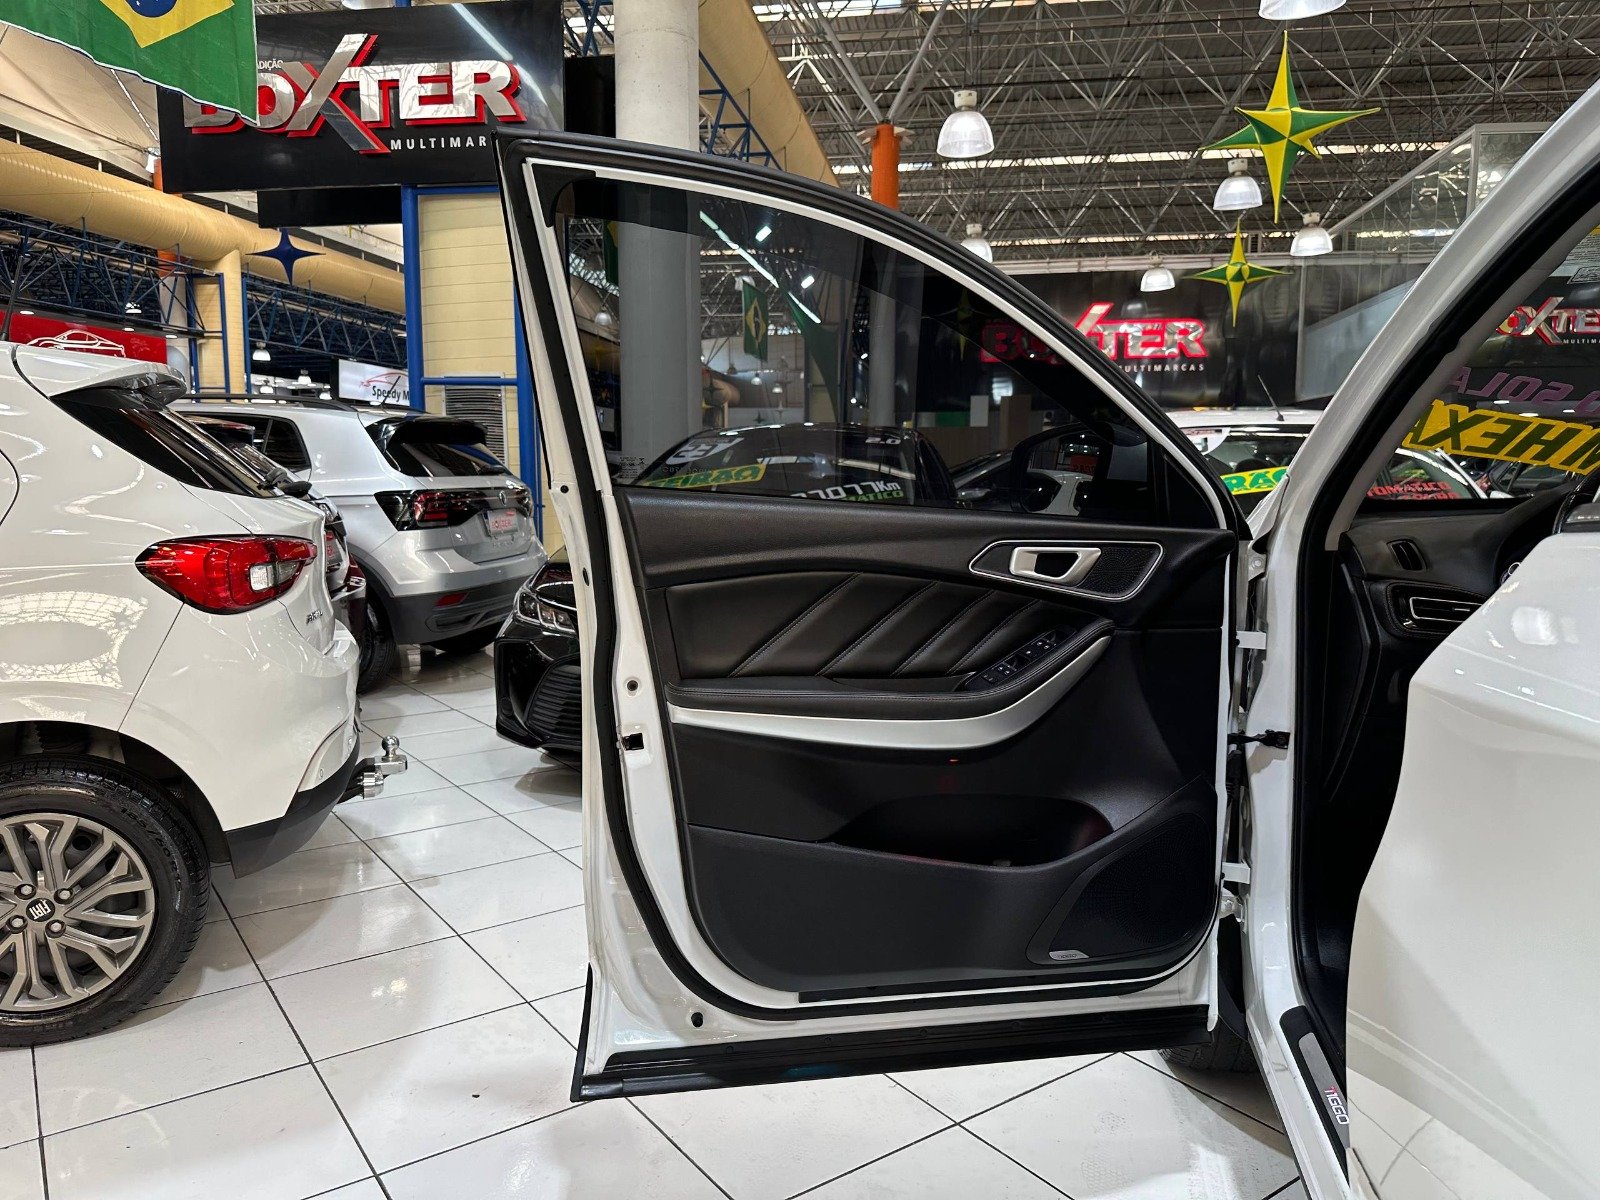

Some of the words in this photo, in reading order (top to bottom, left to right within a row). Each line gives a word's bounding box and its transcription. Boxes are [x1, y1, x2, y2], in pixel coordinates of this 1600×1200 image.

[390, 135, 489, 151] MULTIMAR
[1119, 363, 1205, 374] ULTIMARCAS
[372, 386, 401, 402] Speedy
[29, 900, 52, 921] FIAT
